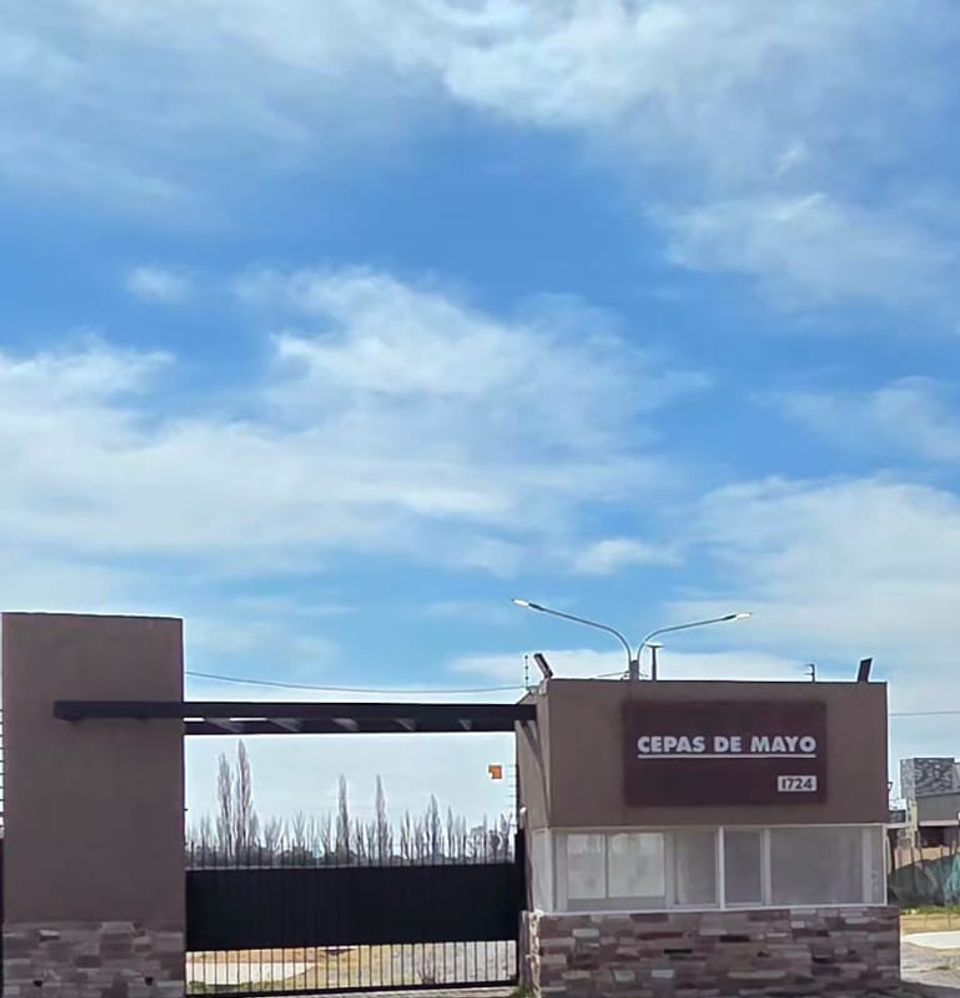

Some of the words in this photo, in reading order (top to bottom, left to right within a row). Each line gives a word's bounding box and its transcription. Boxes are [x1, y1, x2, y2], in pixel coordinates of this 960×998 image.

[637, 736, 705, 753] CEPAS
[714, 736, 742, 753] DE
[751, 736, 816, 753] MAYO
[780, 777, 814, 790] 1724
